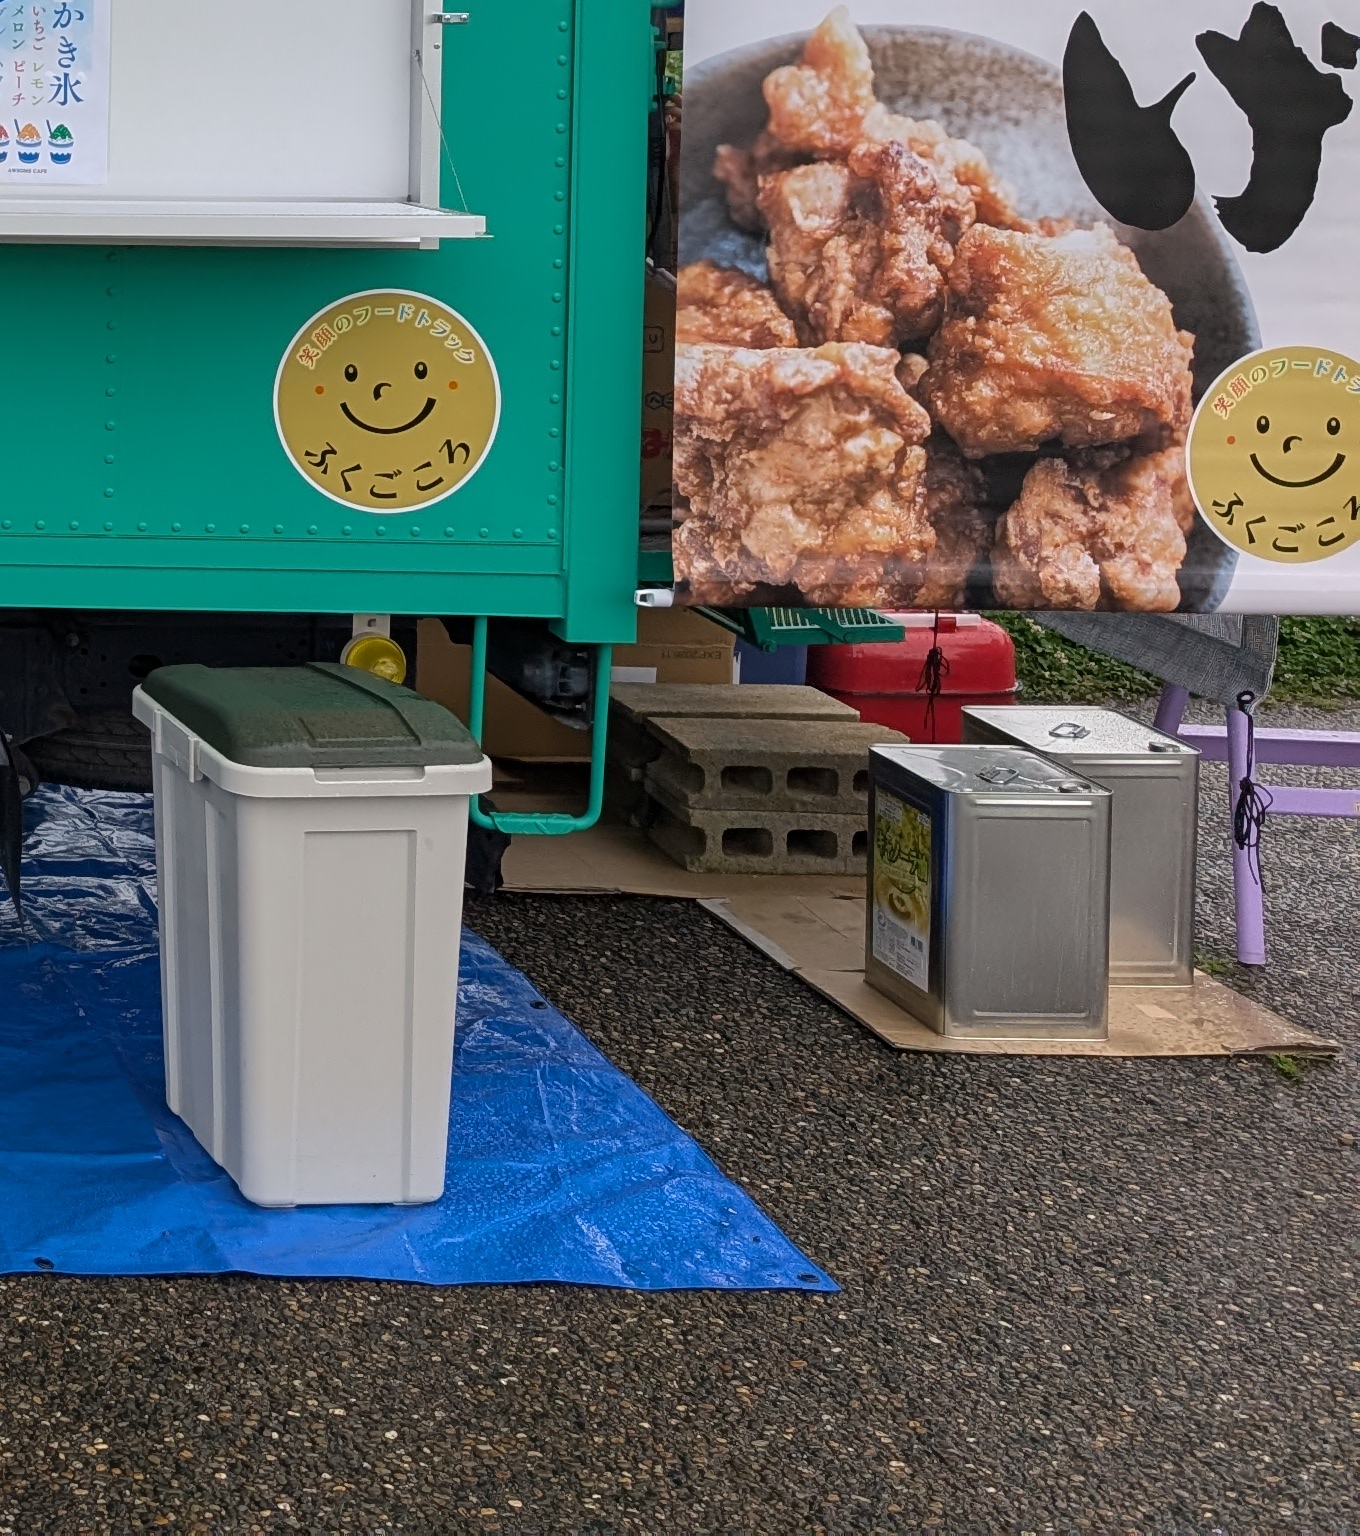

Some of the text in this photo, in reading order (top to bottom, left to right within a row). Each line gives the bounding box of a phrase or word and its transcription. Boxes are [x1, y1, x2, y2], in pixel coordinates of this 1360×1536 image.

[11, 5, 26, 107] メロン ピーチ
[30, 5, 47, 107] いちご レモン
[47, 1, 85, 107] かき氷
[296, 302, 475, 369] 笑顔のフードトラック
